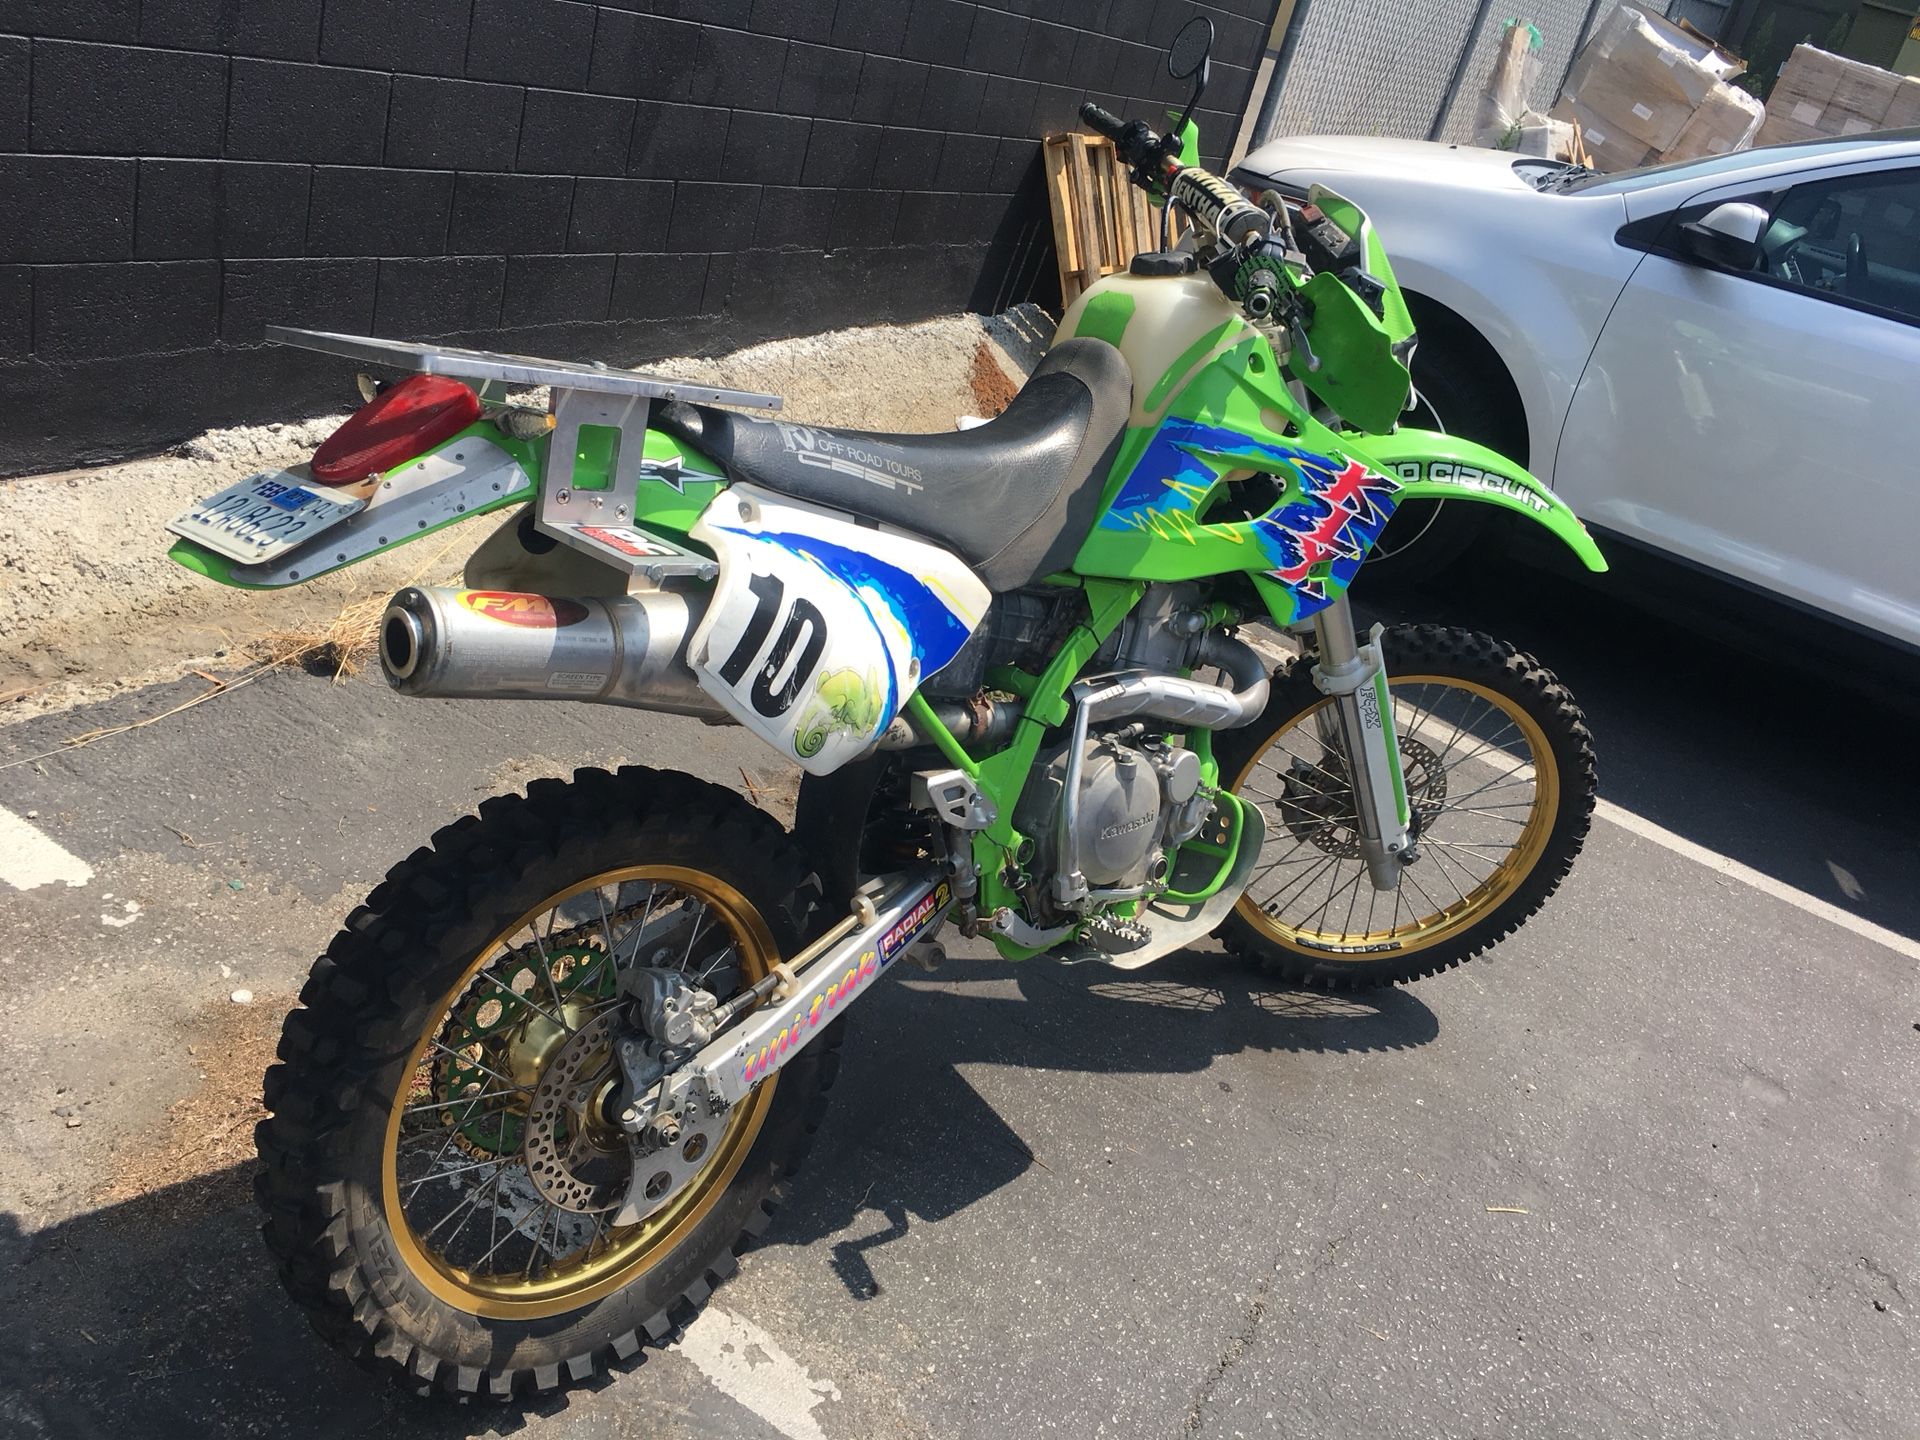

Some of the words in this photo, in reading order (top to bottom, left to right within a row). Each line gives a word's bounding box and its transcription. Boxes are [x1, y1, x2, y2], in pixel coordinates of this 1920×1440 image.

[818, 439, 845, 455] OFF
[847, 447, 883, 468] ROAD
[884, 459, 923, 482] TOURS
[251, 481, 289, 499] FEB
[1428, 461, 1554, 513] CIRCUIT
[719, 572, 828, 718] 10
[1360, 687, 1382, 730] FOX
[1100, 809, 1154, 841] Kawasaki
[883, 898, 935, 951] RADIAL
[935, 883, 950, 911] 2
